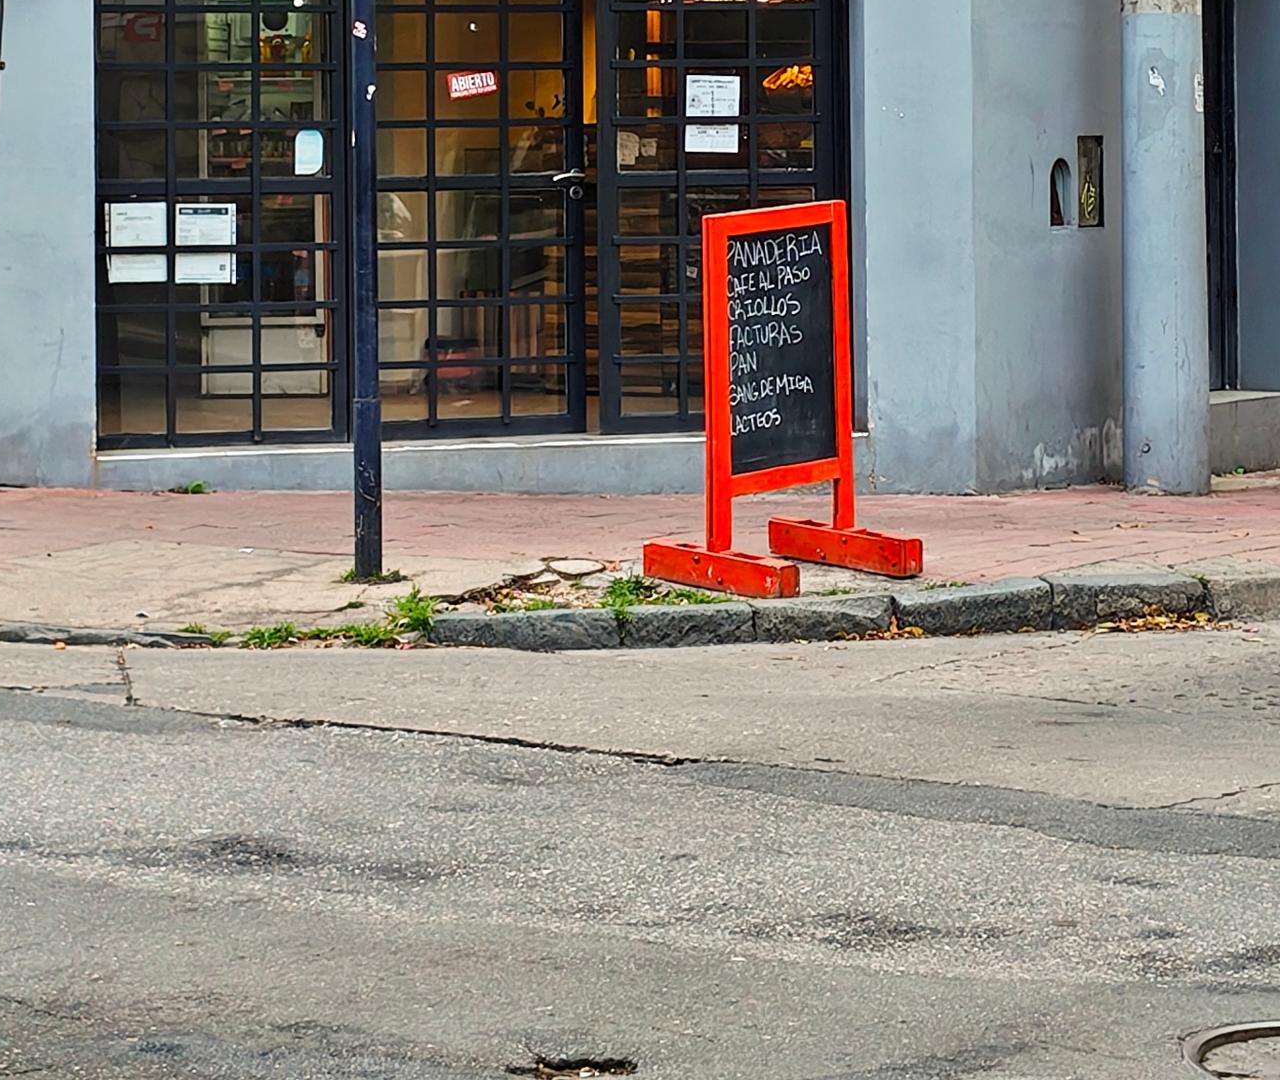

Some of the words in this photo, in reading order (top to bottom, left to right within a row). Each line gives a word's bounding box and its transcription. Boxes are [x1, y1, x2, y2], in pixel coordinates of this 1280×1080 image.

[451, 71, 495, 92] ABIERTO
[726, 230, 823, 268] PANADERIA
[727, 293, 801, 320] CRIOLLOS
[729, 321, 803, 350] FACTURAS
[729, 351, 757, 381] PAN
